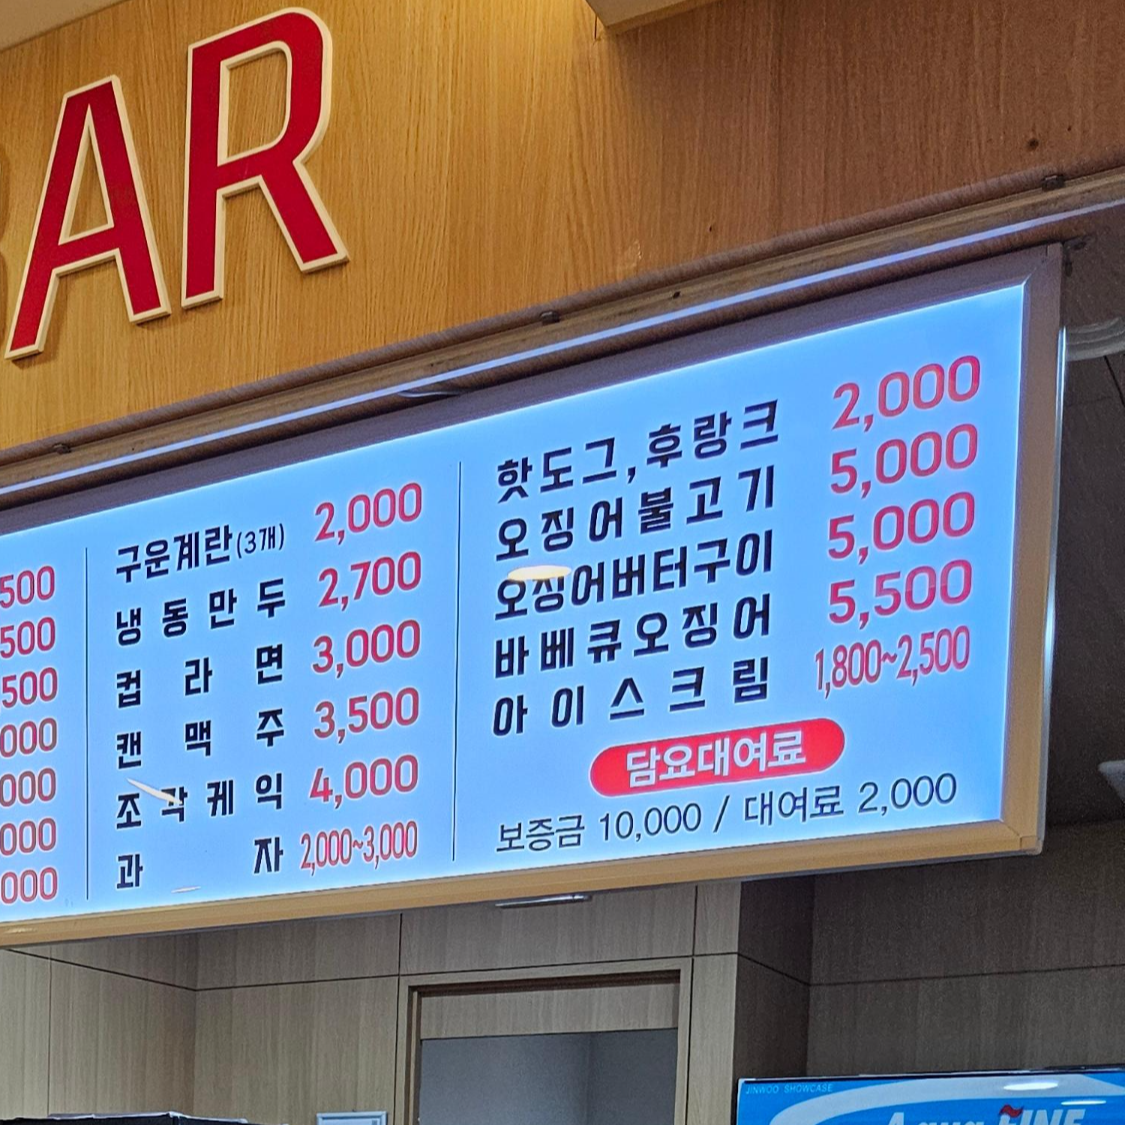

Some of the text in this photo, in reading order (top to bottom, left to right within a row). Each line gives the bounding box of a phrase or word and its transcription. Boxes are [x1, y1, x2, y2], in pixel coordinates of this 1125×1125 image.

[832, 355, 981, 432] 2,000
[314, 482, 423, 545] 2,000
[495, 423, 978, 561] 오징어불고기 5,000
[828, 491, 976, 565] 5,000
[116, 551, 422, 647] 냉동만두 2,700
[495, 559, 974, 679] 바베큐오징어 5,500
[116, 619, 421, 709] 컵라면 3,000
[492, 626, 971, 736] 아이스크림 1,800~2,500
[116, 687, 420, 770] 캔맥주 3,500
[625, 733, 807, 789] 담요대여료
[309, 754, 419, 809] 4,000
[496, 815, 585, 853] 보증금
[599, 802, 703, 845] 10,000
[744, 784, 844, 826] 대여료
[858, 772, 958, 816] 2,000
[300, 820, 418, 878] 2,000~3,000
[745, 1083, 834, 1095] JINWOO SHOWCASE
